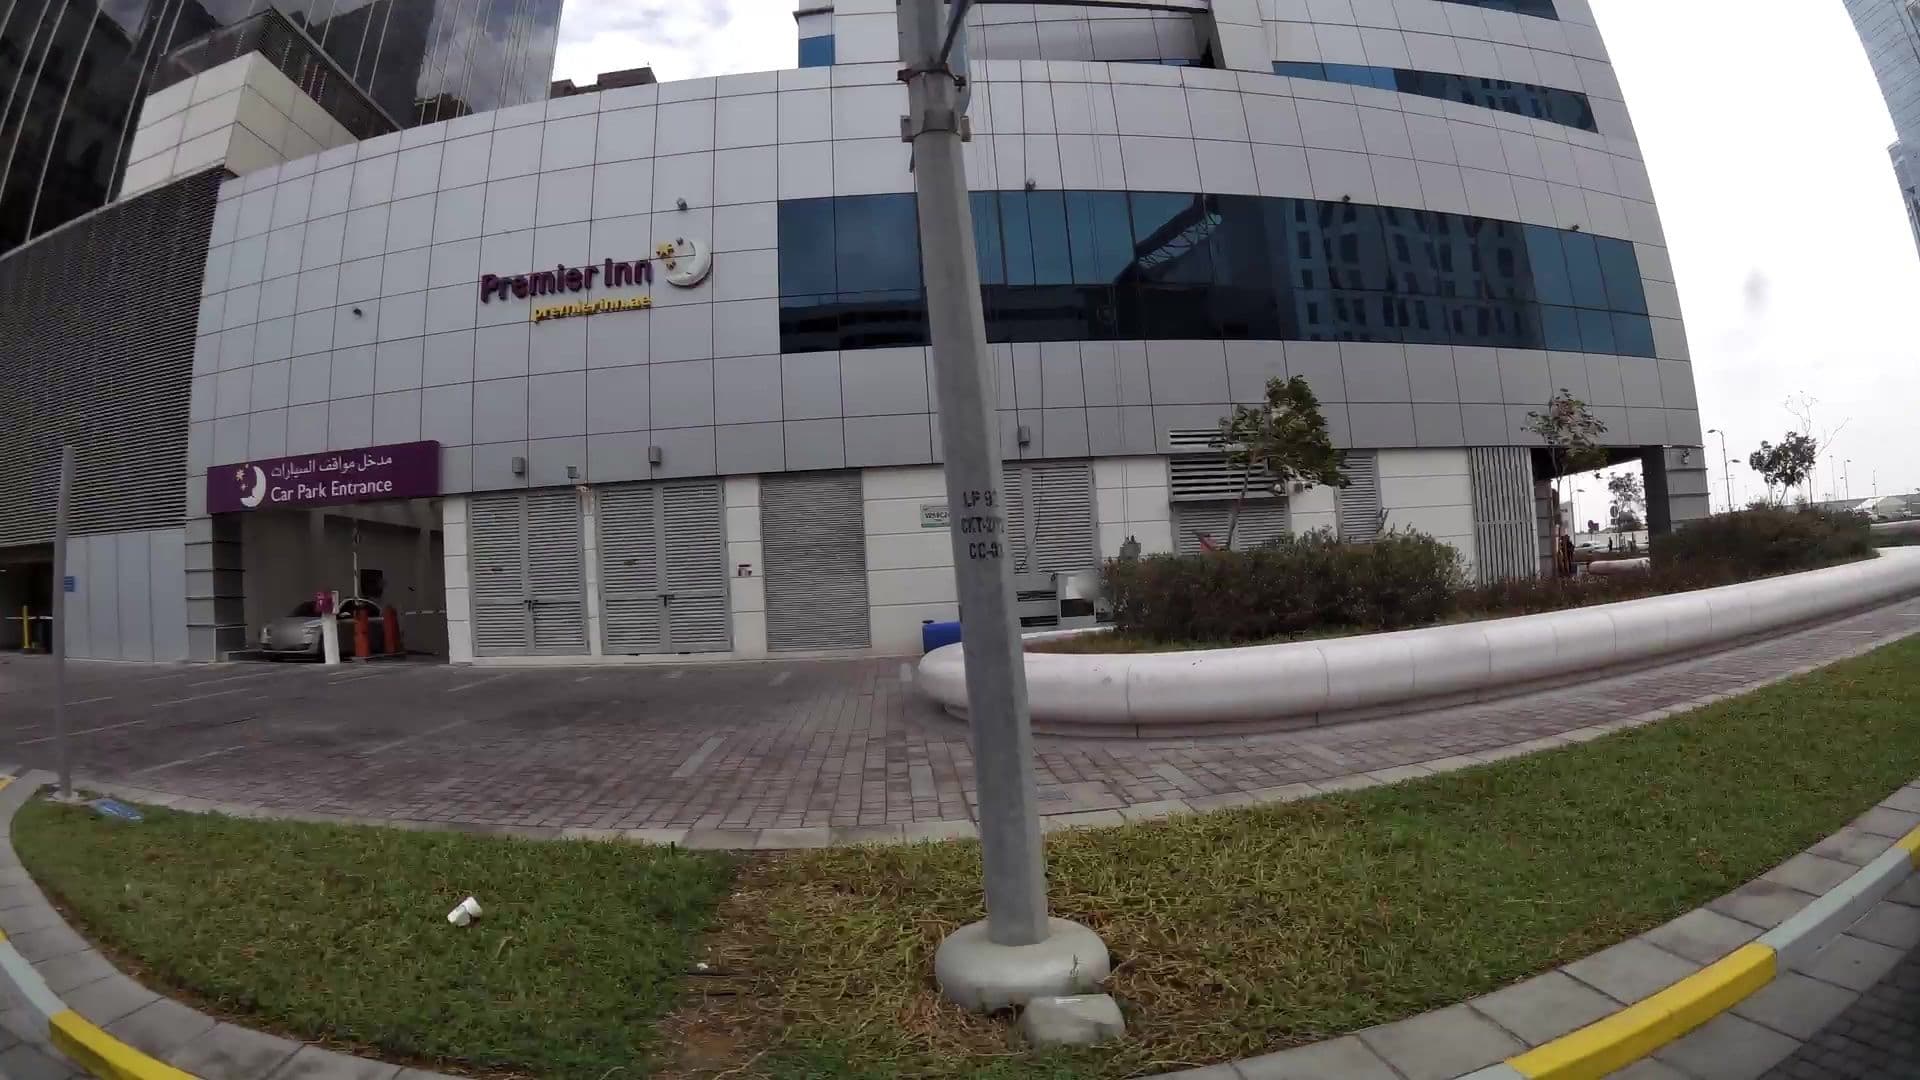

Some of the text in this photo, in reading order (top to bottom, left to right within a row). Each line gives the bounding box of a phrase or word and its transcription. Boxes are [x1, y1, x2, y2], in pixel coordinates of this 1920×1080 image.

[480, 258, 654, 304] Premier Inn
[532, 295, 653, 323] premierinn.ae
[271, 454, 392, 480] مدخل مواقف السيارات
[271, 479, 393, 502] Car Park Entrance
[963, 490, 981, 508] LP
